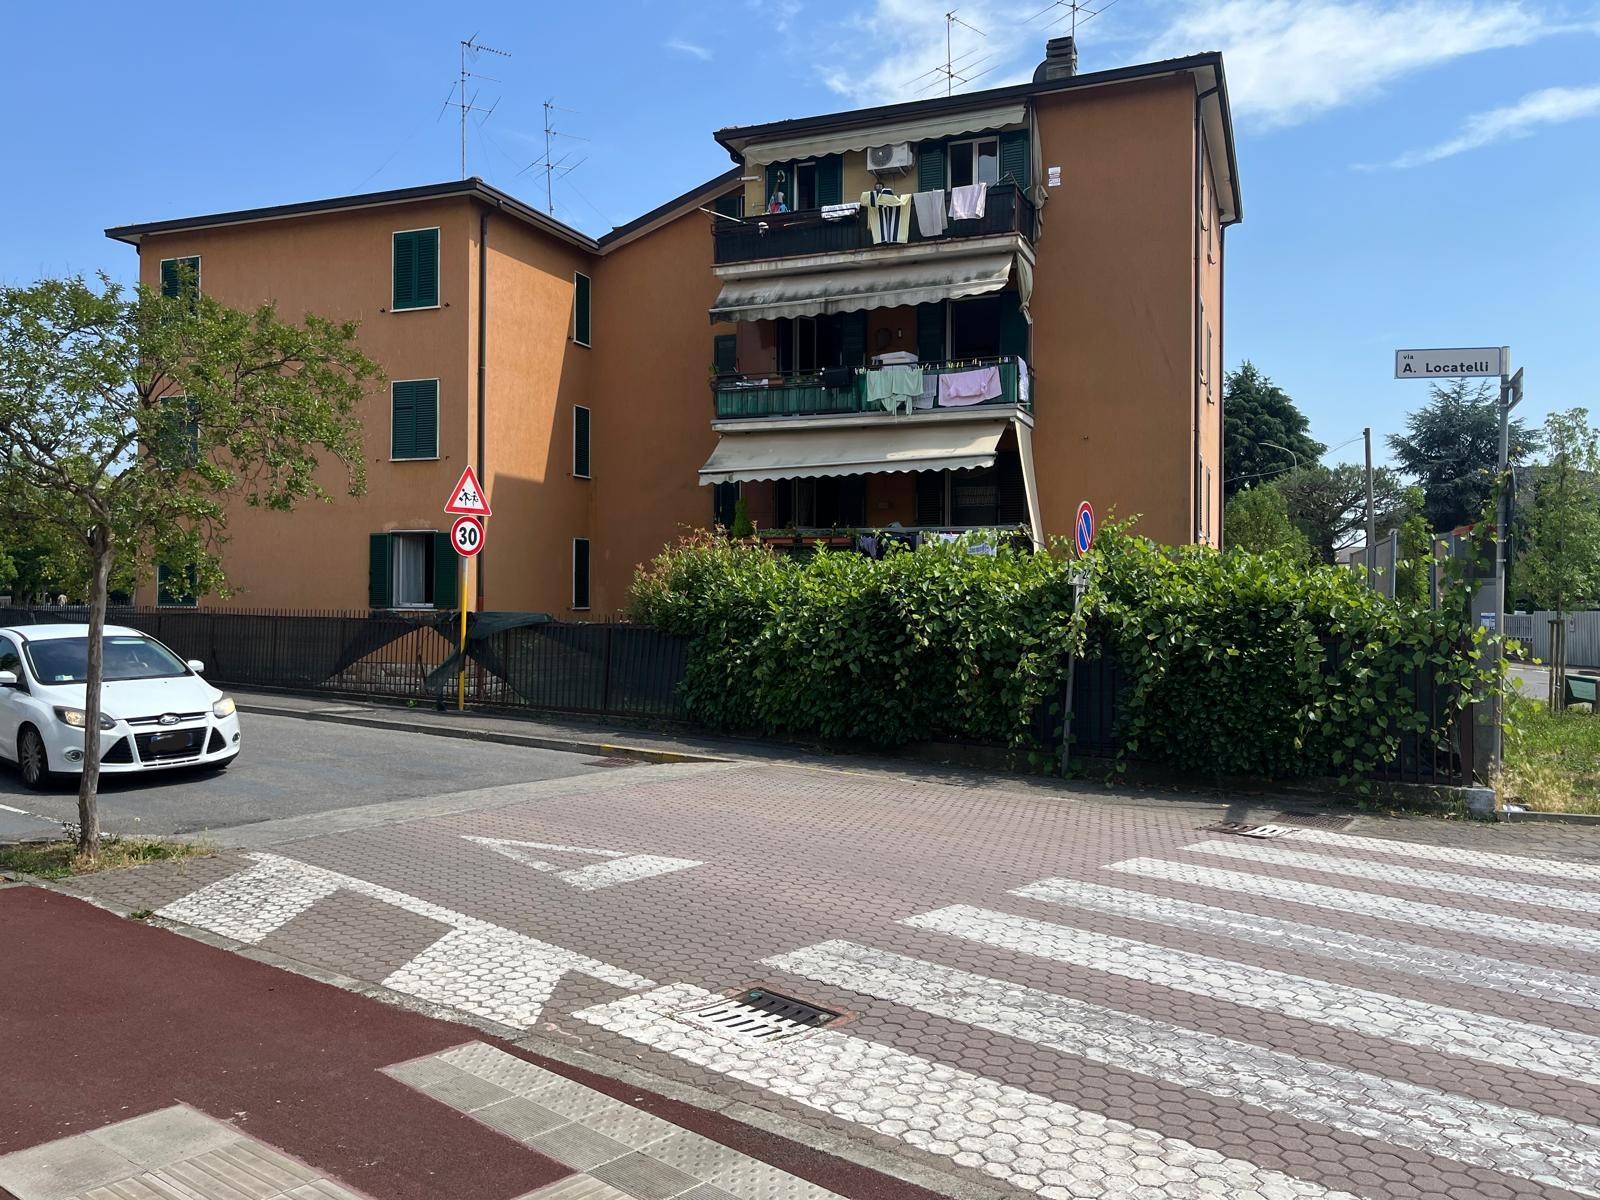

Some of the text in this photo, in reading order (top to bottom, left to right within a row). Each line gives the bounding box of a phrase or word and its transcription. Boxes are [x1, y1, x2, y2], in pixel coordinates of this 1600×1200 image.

[1403, 361, 1489, 373] A. Locatelli
[459, 527, 477, 545] 30
